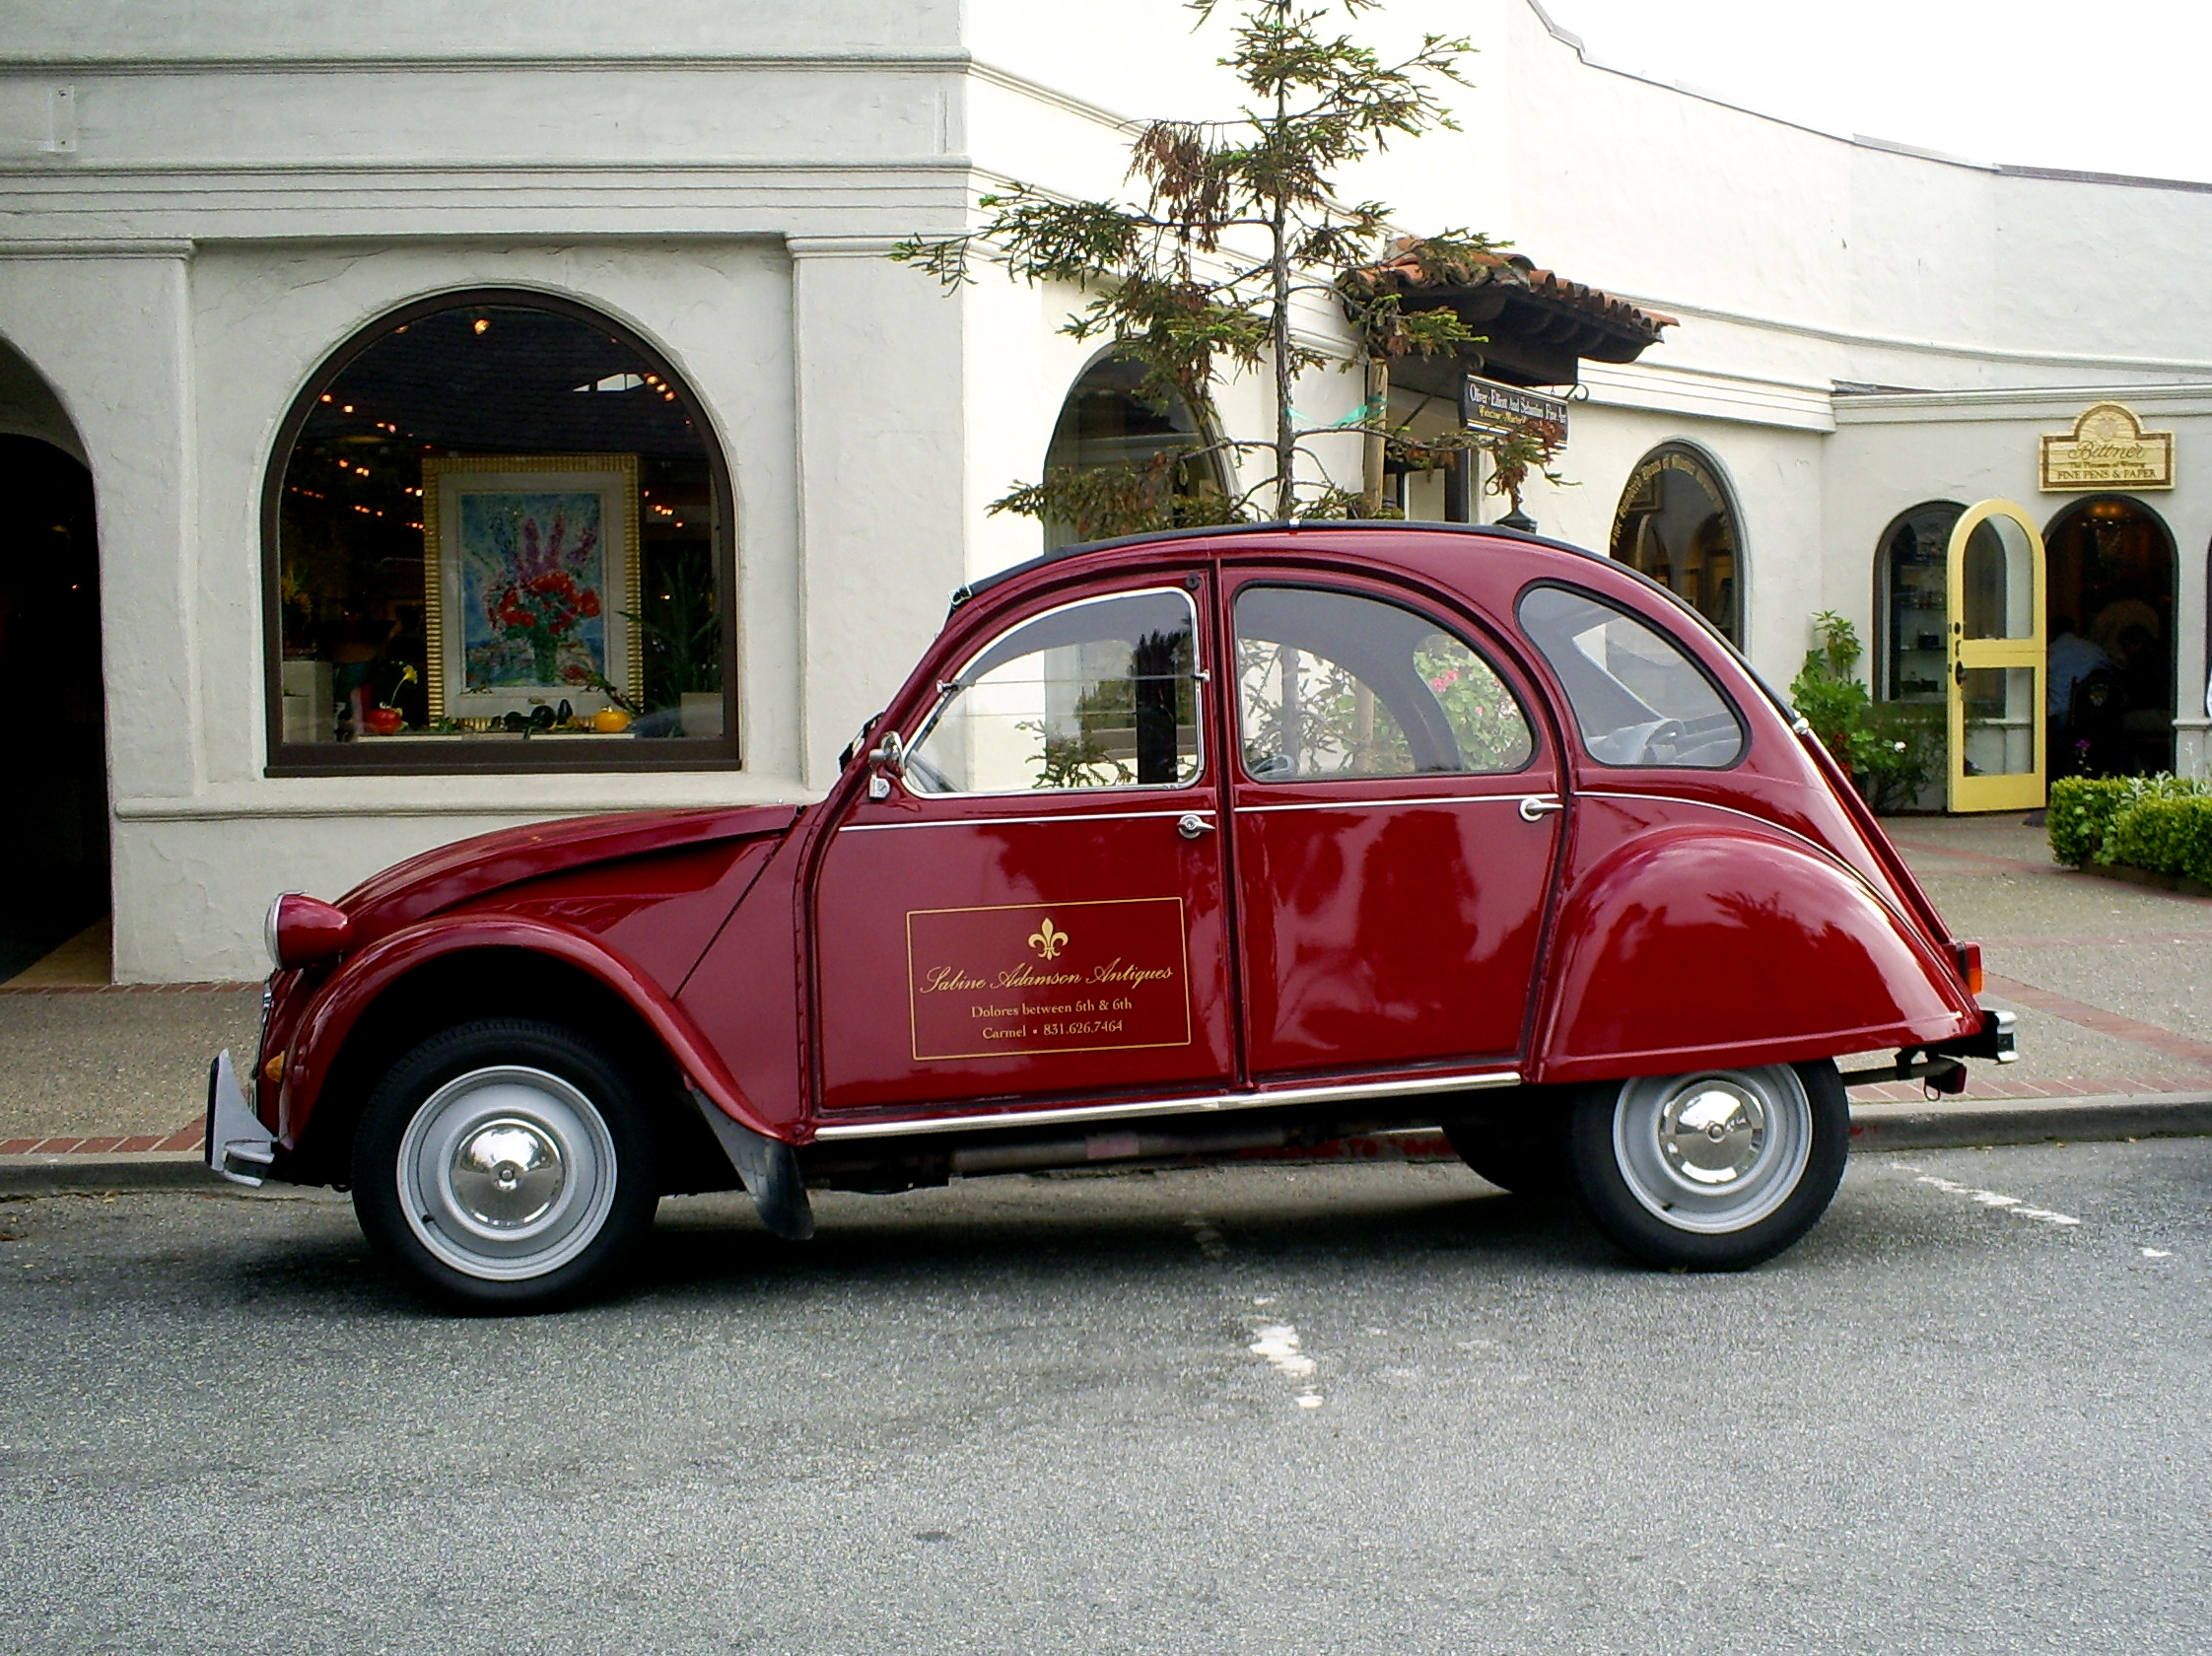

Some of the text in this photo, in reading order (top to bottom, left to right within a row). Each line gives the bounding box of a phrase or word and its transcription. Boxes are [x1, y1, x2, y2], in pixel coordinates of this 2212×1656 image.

[2057, 468, 2157, 480] FINE PENS & PAPER
[919, 957, 1174, 994] Sabine Adamson Antiques
[971, 1004, 1019, 1018] Dolores
[1021, 1001, 1072, 1015] between
[1098, 1000, 1110, 1011] &
[1112, 998, 1133, 1010] 6th
[982, 1019, 1124, 1040] Carmel 831.626.7464
